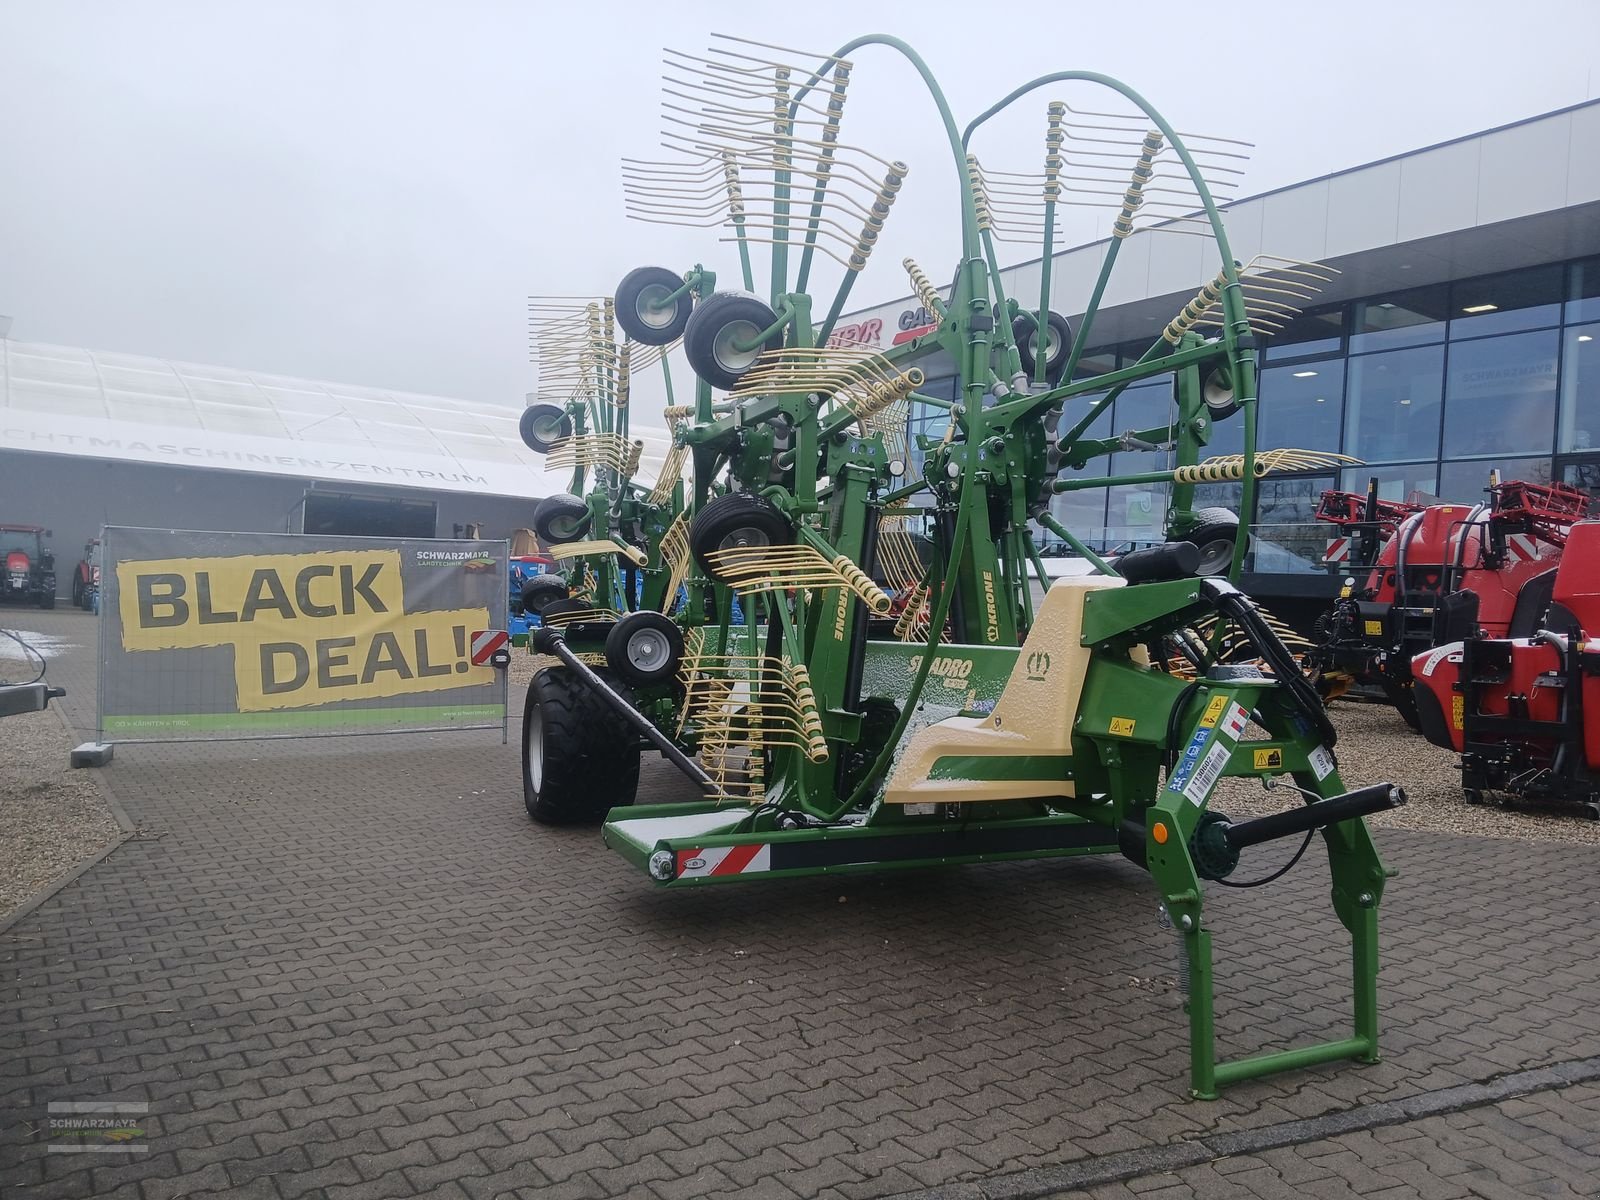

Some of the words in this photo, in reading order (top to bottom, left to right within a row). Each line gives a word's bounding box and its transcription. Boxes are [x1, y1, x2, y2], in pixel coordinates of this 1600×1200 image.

[416, 550, 489, 560] SCHWARZMAYR
[136, 563, 389, 629] BLACK
[834, 586, 849, 642] KRONE
[983, 571, 998, 626] KRONE
[259, 625, 469, 695] DEAL!
[1192, 756, 1213, 786] 1130602
